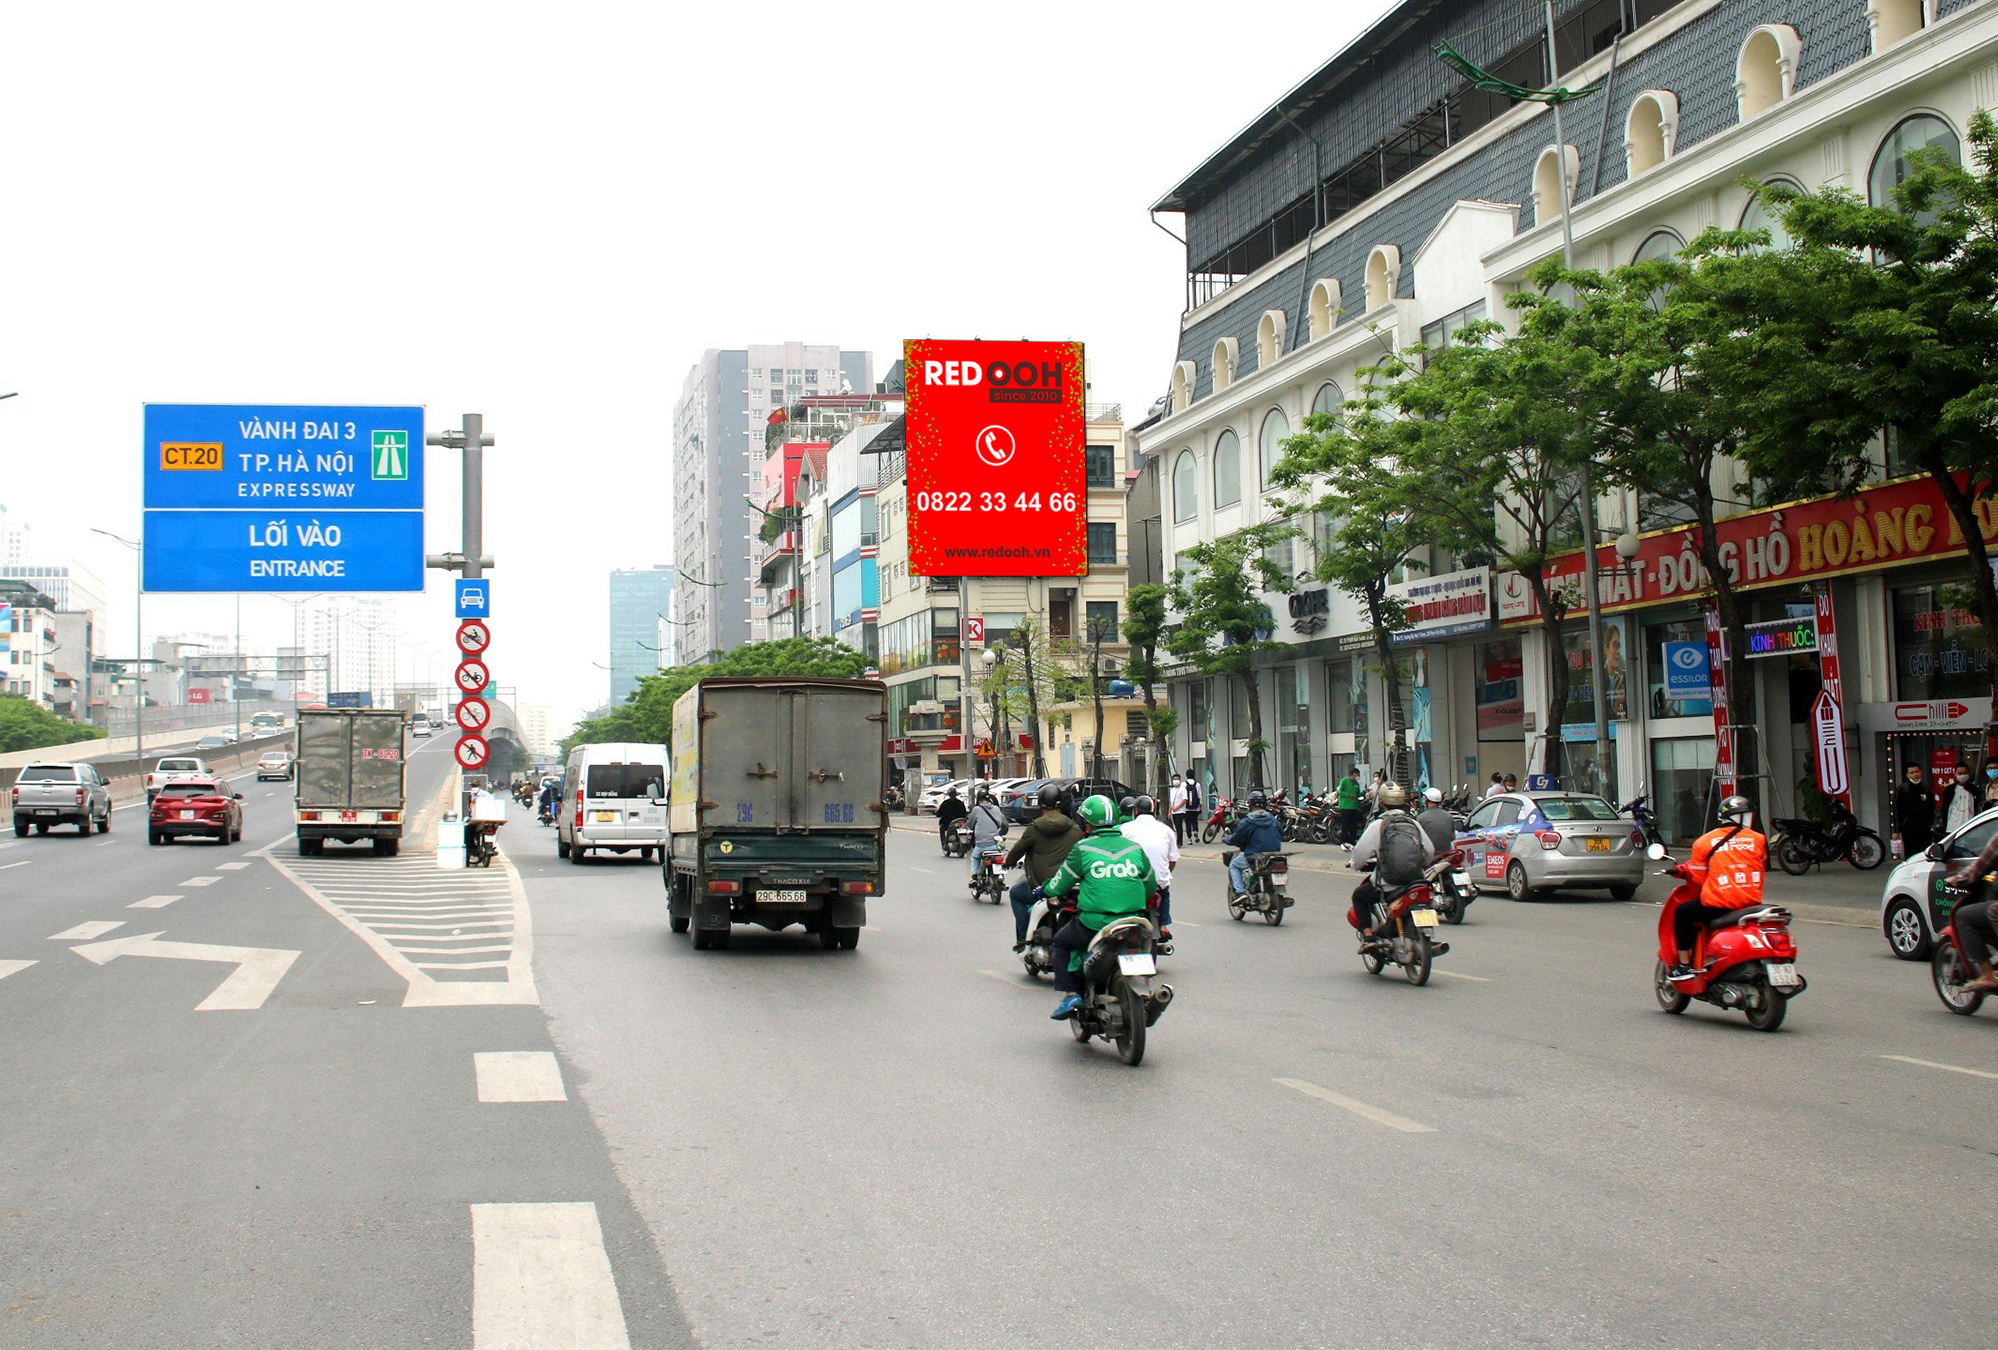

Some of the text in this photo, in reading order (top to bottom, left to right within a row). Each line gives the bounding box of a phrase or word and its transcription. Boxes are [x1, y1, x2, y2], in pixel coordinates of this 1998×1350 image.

[924, 360, 1062, 387] RED OOH
[994, 390, 1058, 401] since 2010
[239, 416, 356, 439] VÀNH ĐAI 3
[164, 447, 219, 465] CT.20
[316, 451, 354, 476] NỘI
[238, 483, 355, 497] EXPRESSWAY
[916, 491, 1076, 512] 0822 33 44 66
[250, 519, 341, 547] LỐI VÀO
[1746, 512, 1790, 580] HỒ
[1798, 500, 1936, 572] HOÀNG
[944, 545, 1050, 558] www.redooh.vn
[250, 560, 345, 577] ENTRANCE
[1750, 631, 1774, 651] KÍNH
[737, 803, 753, 823] 29C
[1081, 805, 1093, 817] Grab
[1730, 842, 1755, 852] Food
[1090, 858, 1139, 879] Grab
[1487, 855, 1504, 865] ENEOS
[757, 891, 805, 901] 29C-665.66
